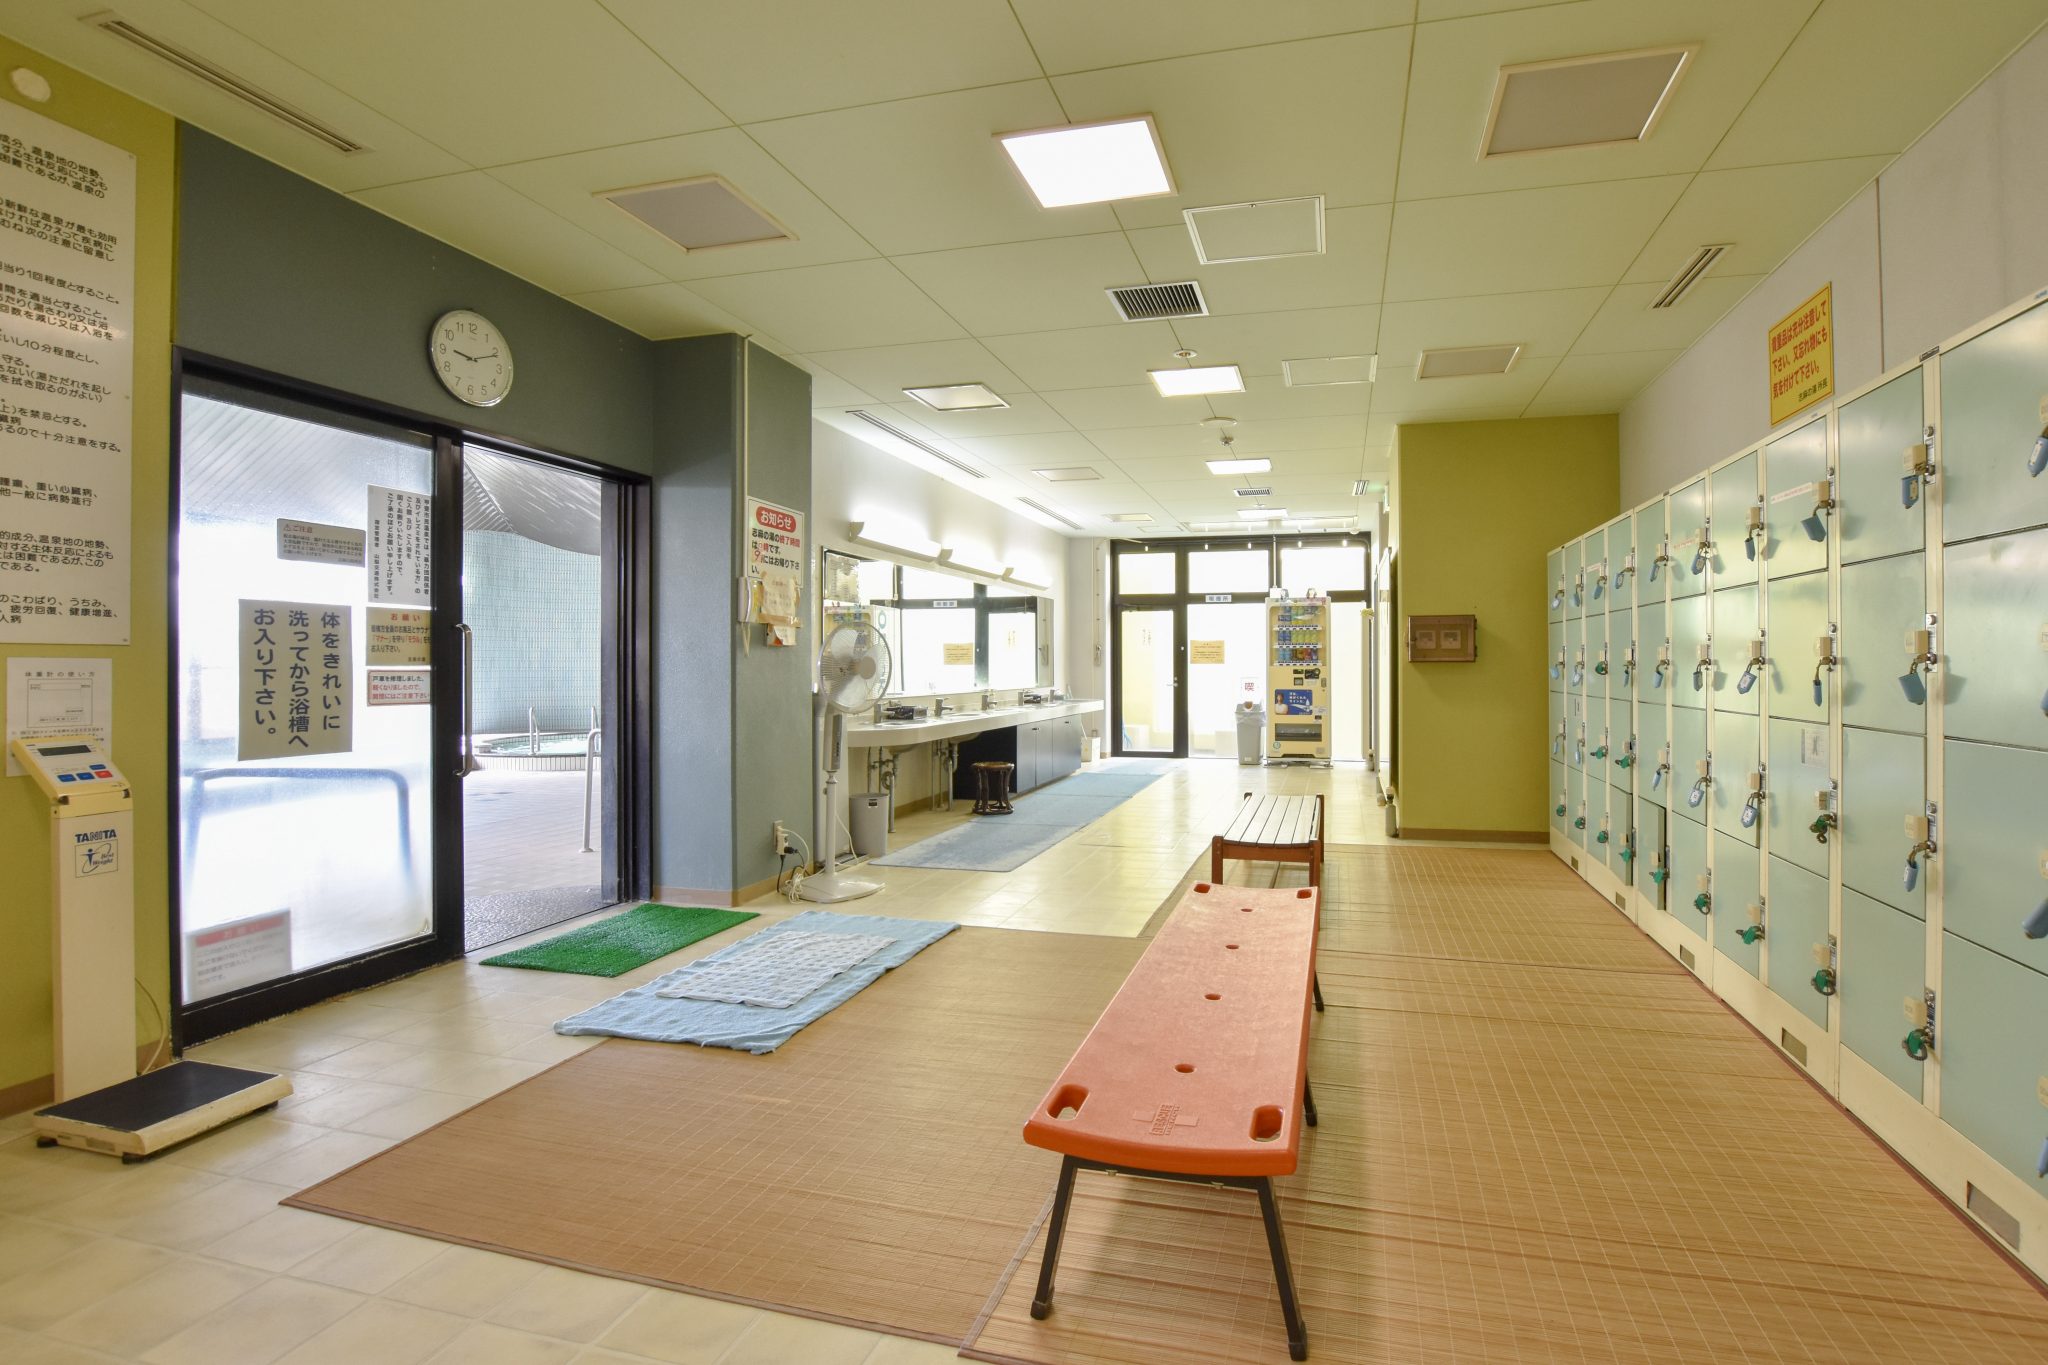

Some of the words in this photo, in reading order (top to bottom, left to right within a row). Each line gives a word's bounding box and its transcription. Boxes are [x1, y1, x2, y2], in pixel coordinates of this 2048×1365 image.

[0, 262, 119, 305] 当り1回程度とすること。
[0, 282, 108, 321] 間を適当とすること。
[456, 322, 464, 334] 11
[468, 322, 478, 335] 12
[444, 329, 454, 341] 10
[484, 333, 489, 343] 1
[0, 334, 99, 365] いし10分程度とし、
[440, 343, 446, 355] 9
[492, 347, 499, 358] 2
[443, 361, 451, 372] 8
[496, 363, 503, 375] 3
[455, 376, 461, 386] 7
[490, 378, 496, 388] 4
[467, 385, 474, 395] 6
[480, 385, 488, 396] 5
[761, 510, 792, 530] お知らせ
[0, 551, 105, 568] は困難であるが、この
[254, 608, 277, 735] お入り下さい。
[321, 612, 341, 731] 体をきれいに
[288, 610, 310, 748] 洗ってから浴槽へ
[74, 829, 117, 843] TANITA
